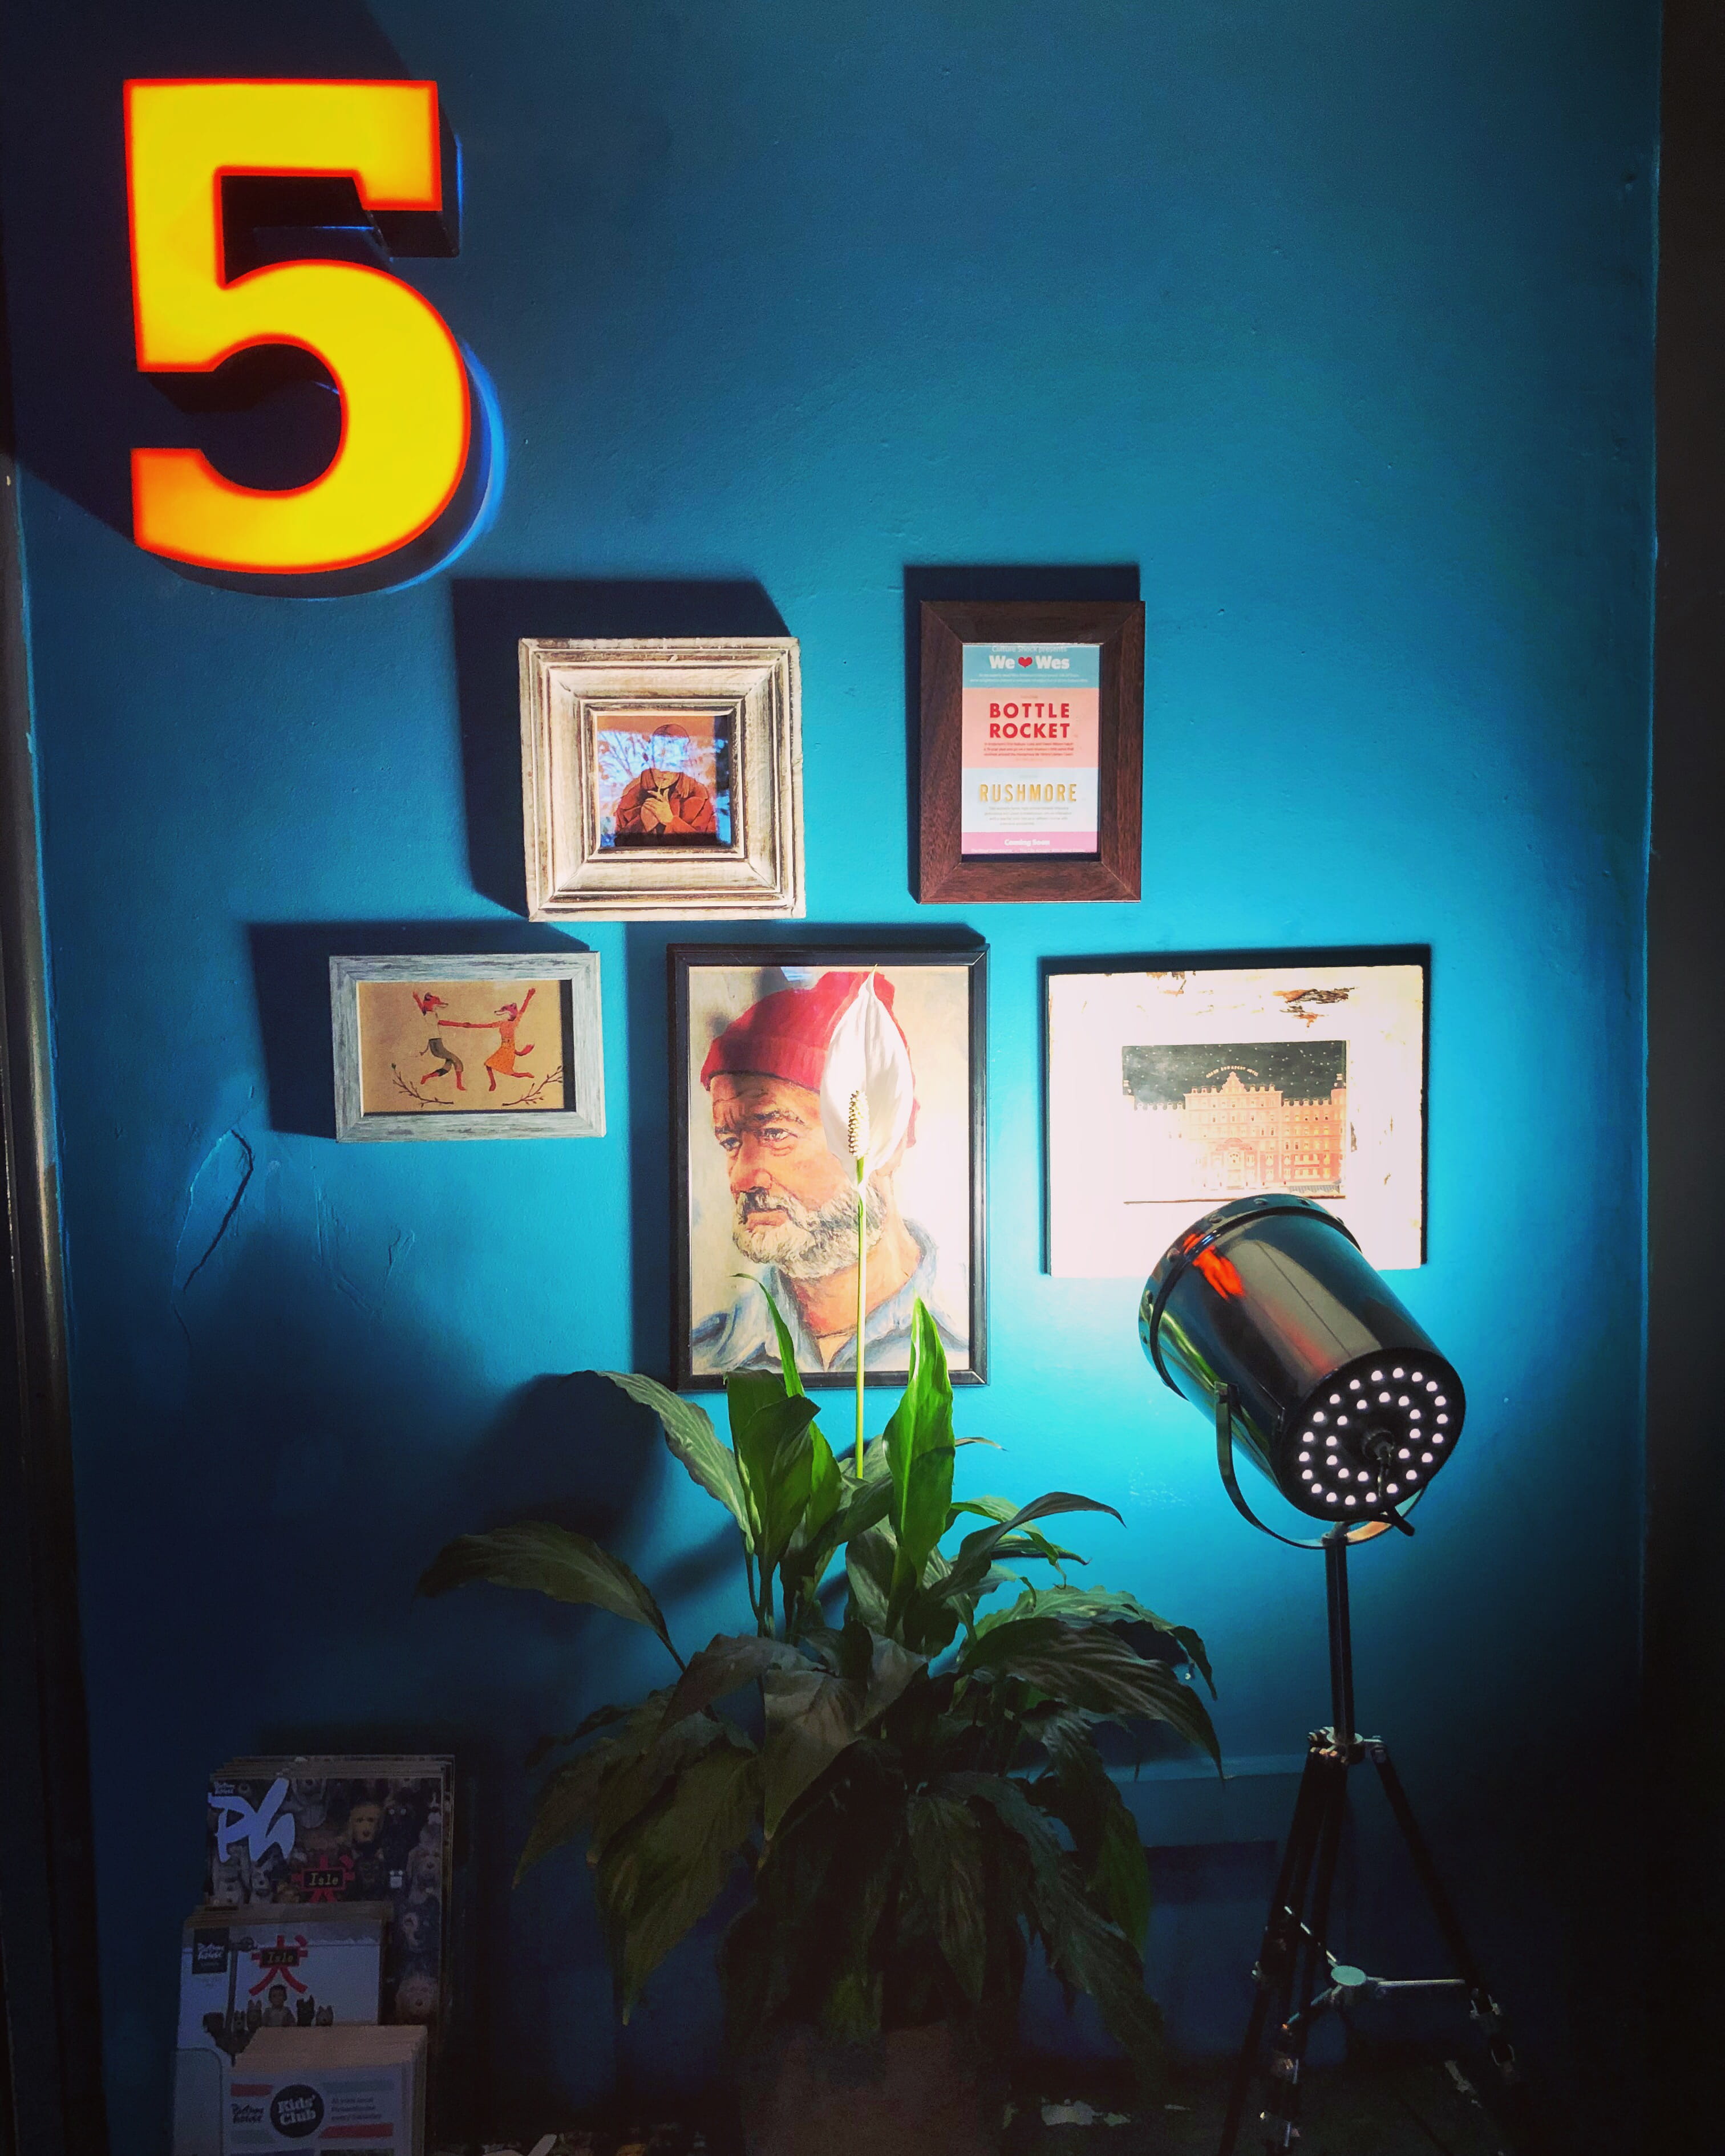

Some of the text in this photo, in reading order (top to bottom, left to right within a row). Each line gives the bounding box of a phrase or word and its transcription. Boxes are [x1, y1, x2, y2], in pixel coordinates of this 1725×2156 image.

[123, 78, 471, 574] 5
[989, 655, 1070, 669] We Wes
[990, 703, 1070, 718] BOTTLE
[990, 723, 1070, 739] ROCKET
[979, 784, 1077, 802] RUSHMORE
[309, 1872, 339, 1886] Isle
[267, 1951, 294, 1964] Isle
[280, 2109, 317, 2126] Club
